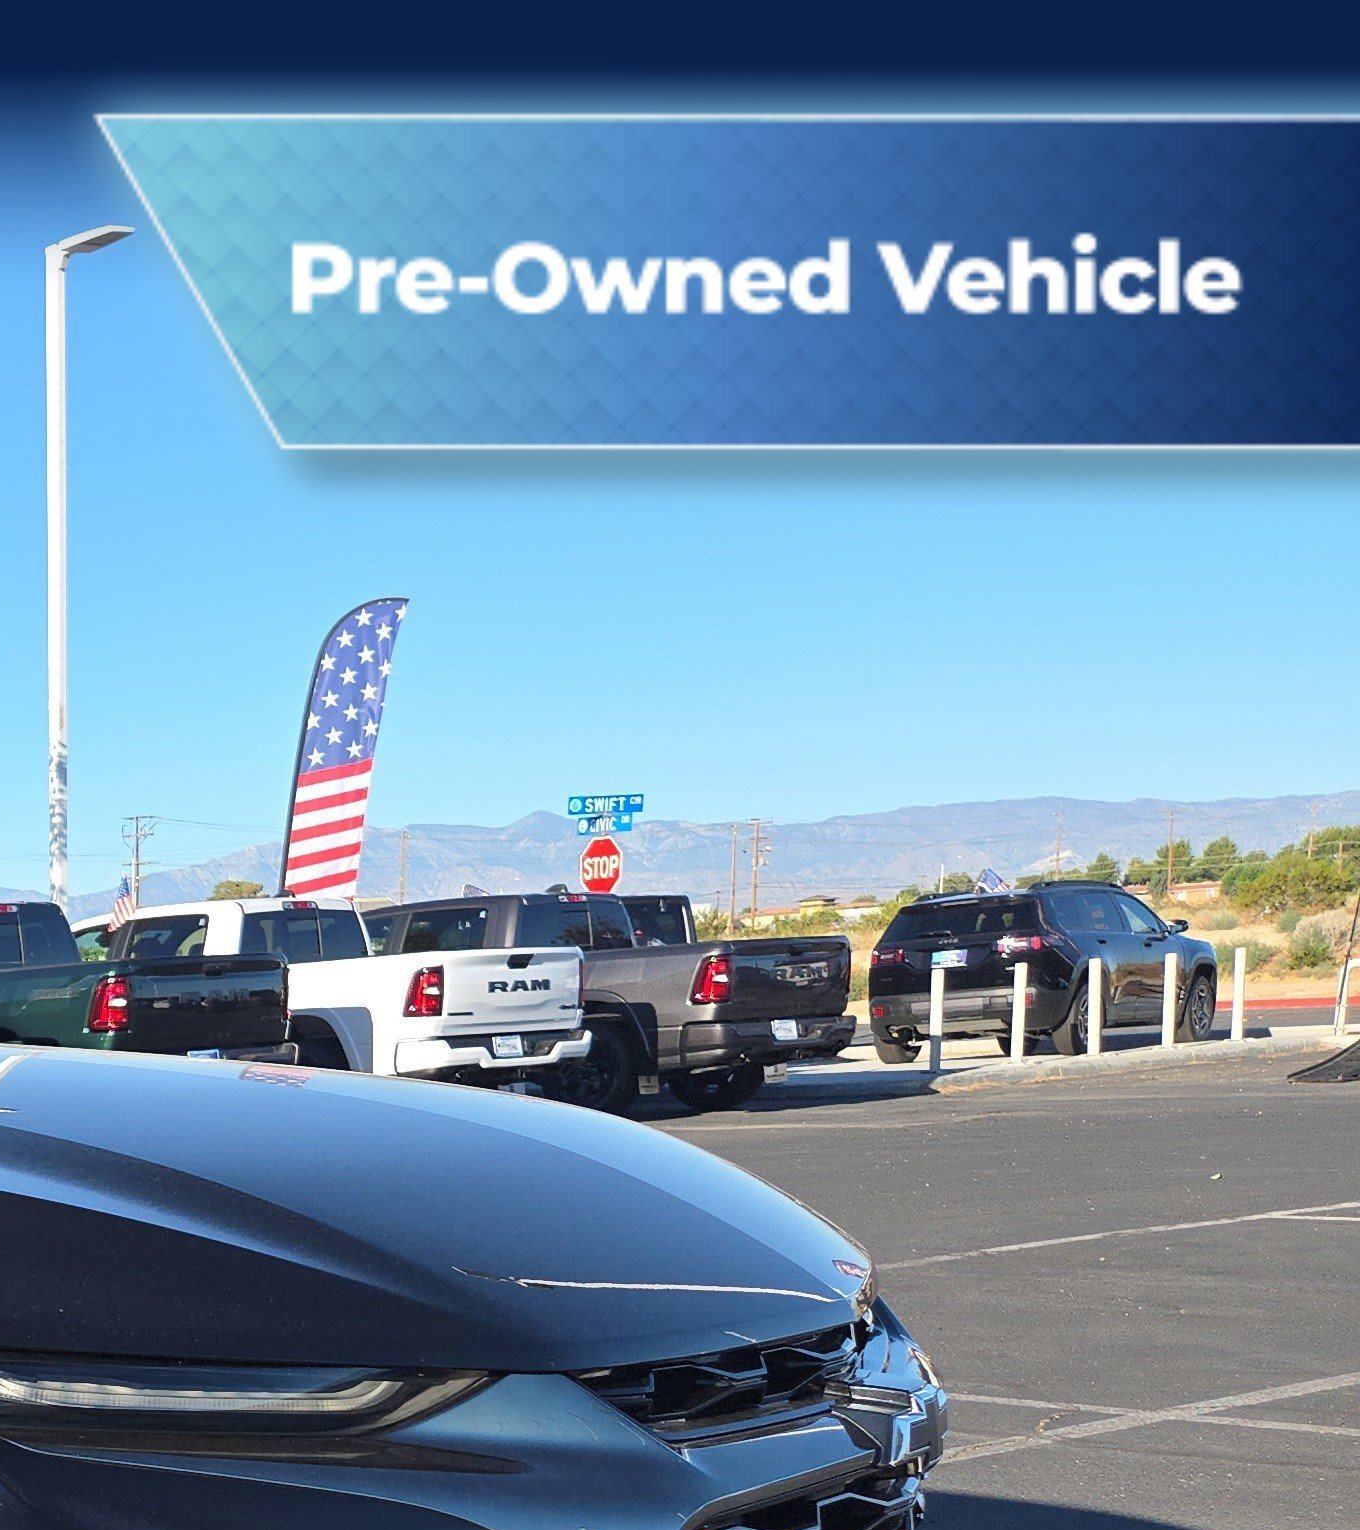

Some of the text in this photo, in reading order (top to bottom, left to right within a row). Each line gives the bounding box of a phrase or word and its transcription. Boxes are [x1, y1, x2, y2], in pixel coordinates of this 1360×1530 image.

[584, 796, 626, 812] SWIFT
[589, 816, 617, 832] CIVIC
[583, 855, 619, 880] STOP
[488, 979, 551, 993] RAM
